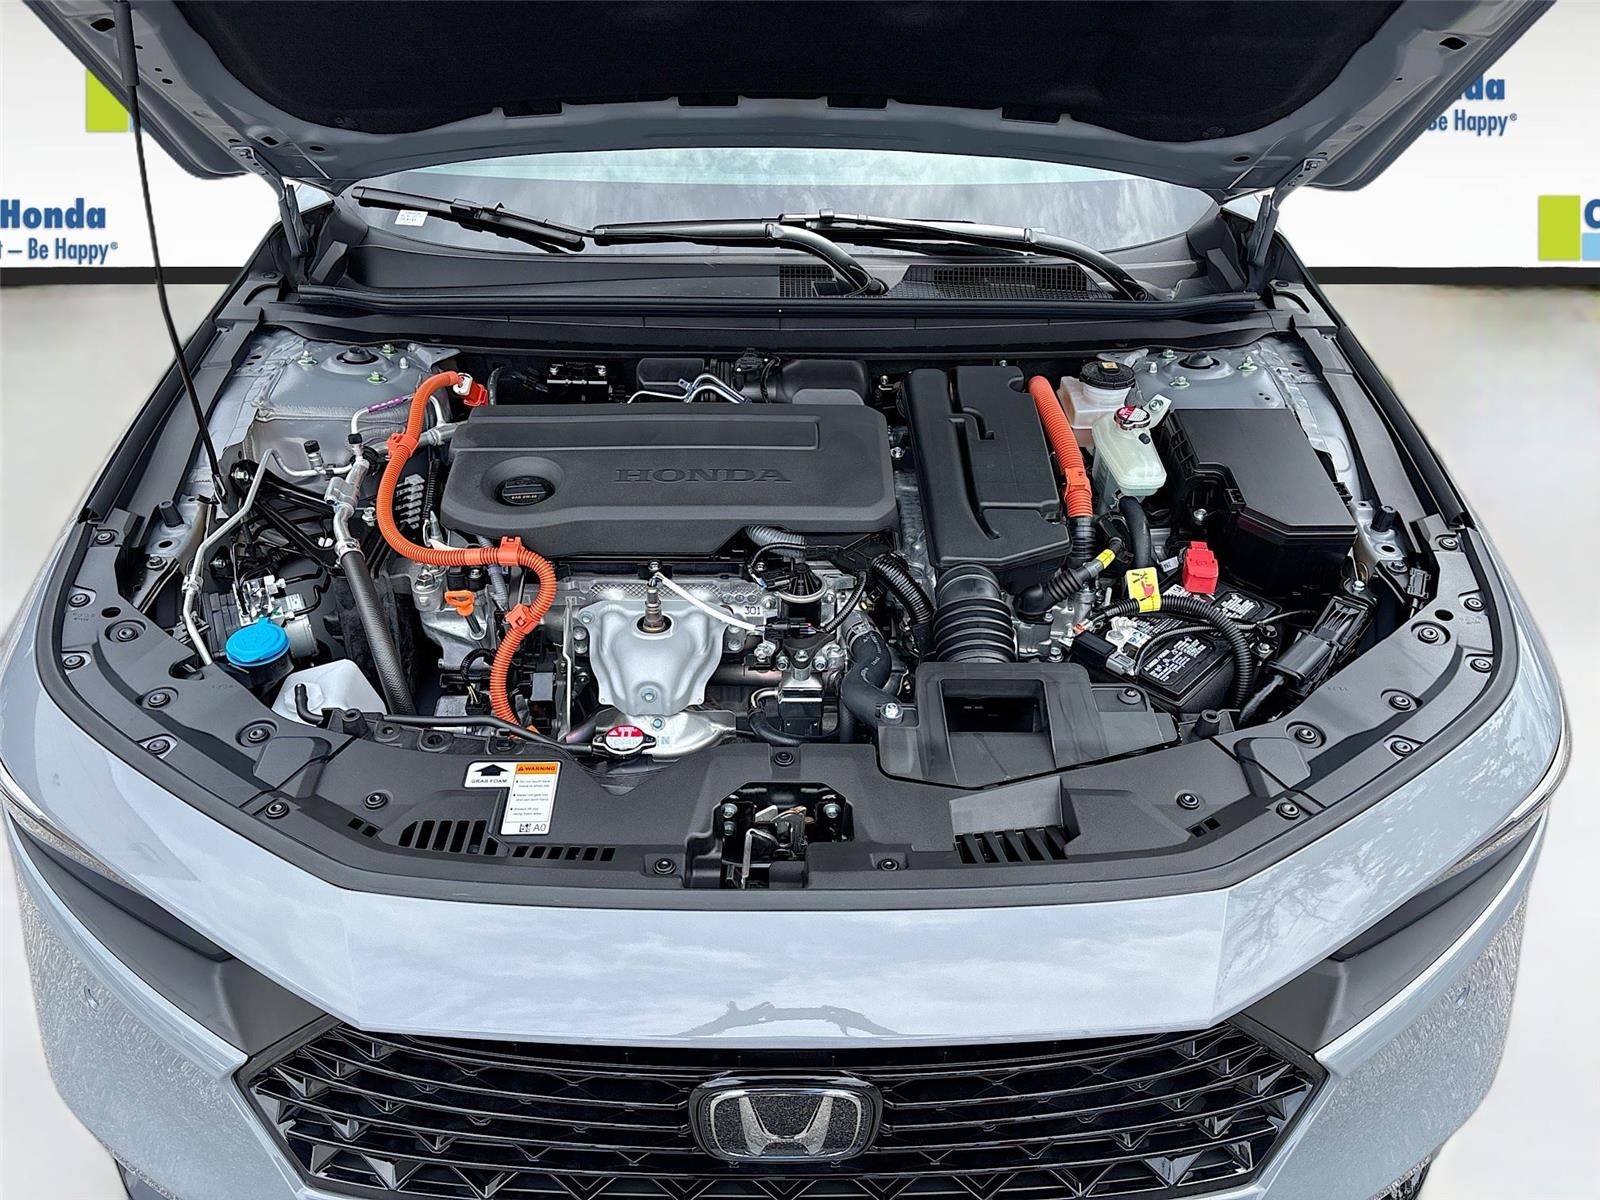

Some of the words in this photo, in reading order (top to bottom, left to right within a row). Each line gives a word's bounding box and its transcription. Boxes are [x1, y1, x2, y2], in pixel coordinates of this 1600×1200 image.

[0, 197, 106, 229] Honda
[28, 238, 49, 260] Be
[615, 468, 792, 484] HONDA
